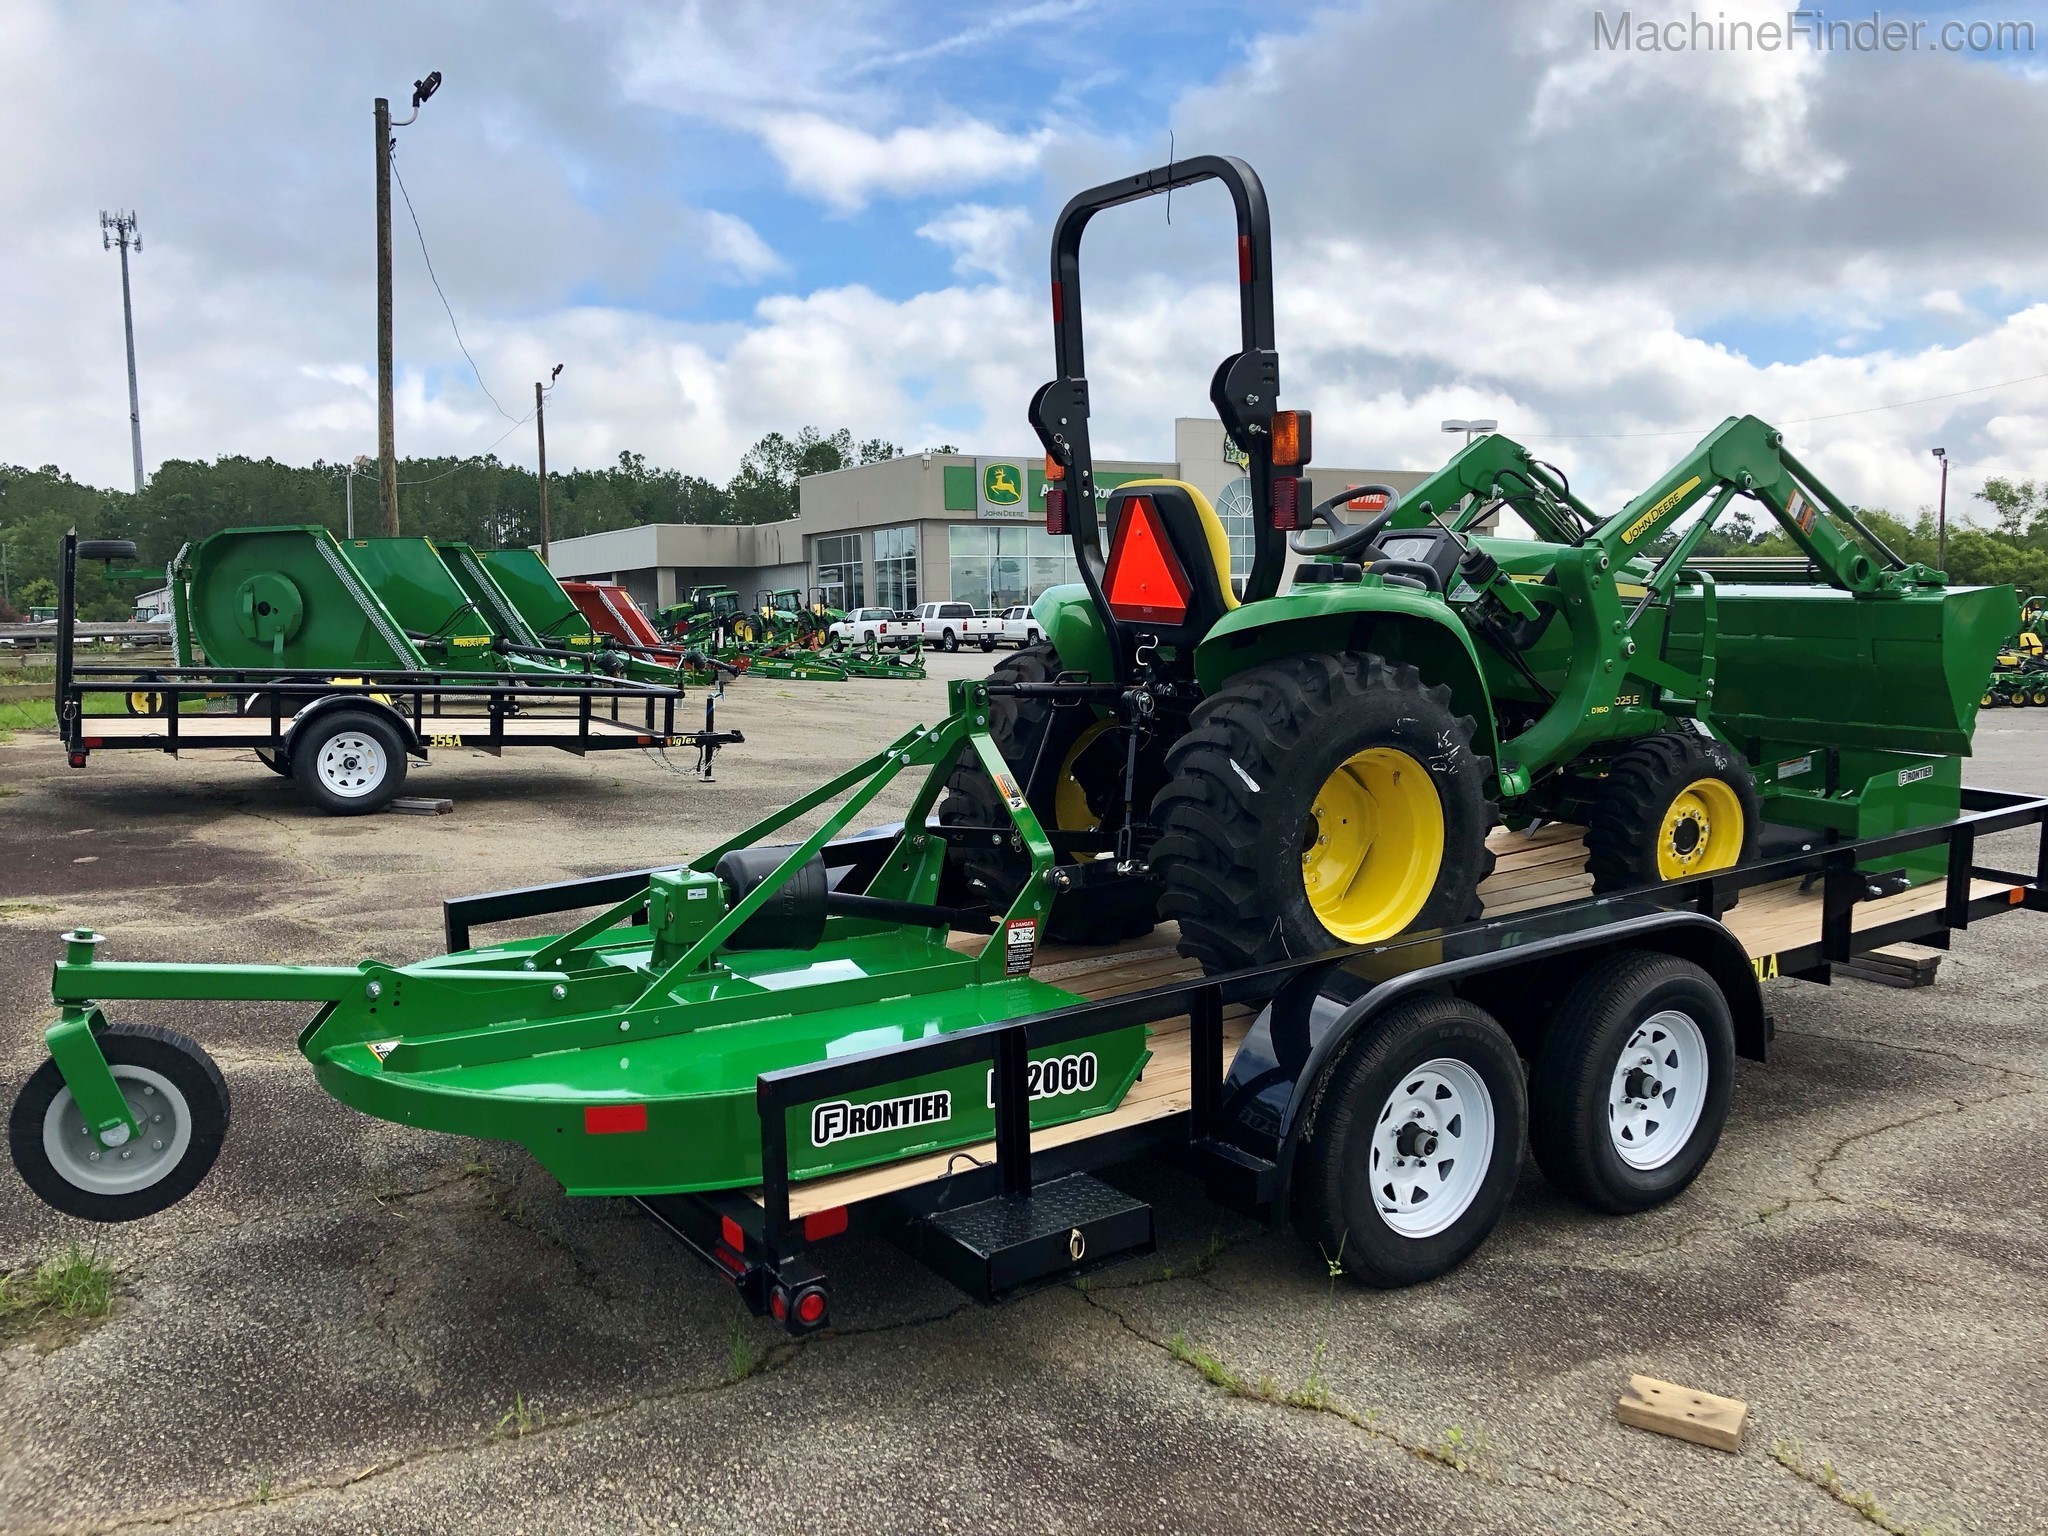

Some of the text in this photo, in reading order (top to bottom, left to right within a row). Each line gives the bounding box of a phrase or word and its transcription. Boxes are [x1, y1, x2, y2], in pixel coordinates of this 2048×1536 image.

[1627, 492, 1680, 542] JOHN DEERE
[1899, 765, 1933, 786] FRONTIER
[813, 1055, 1096, 1144] FRONTIER 2060
